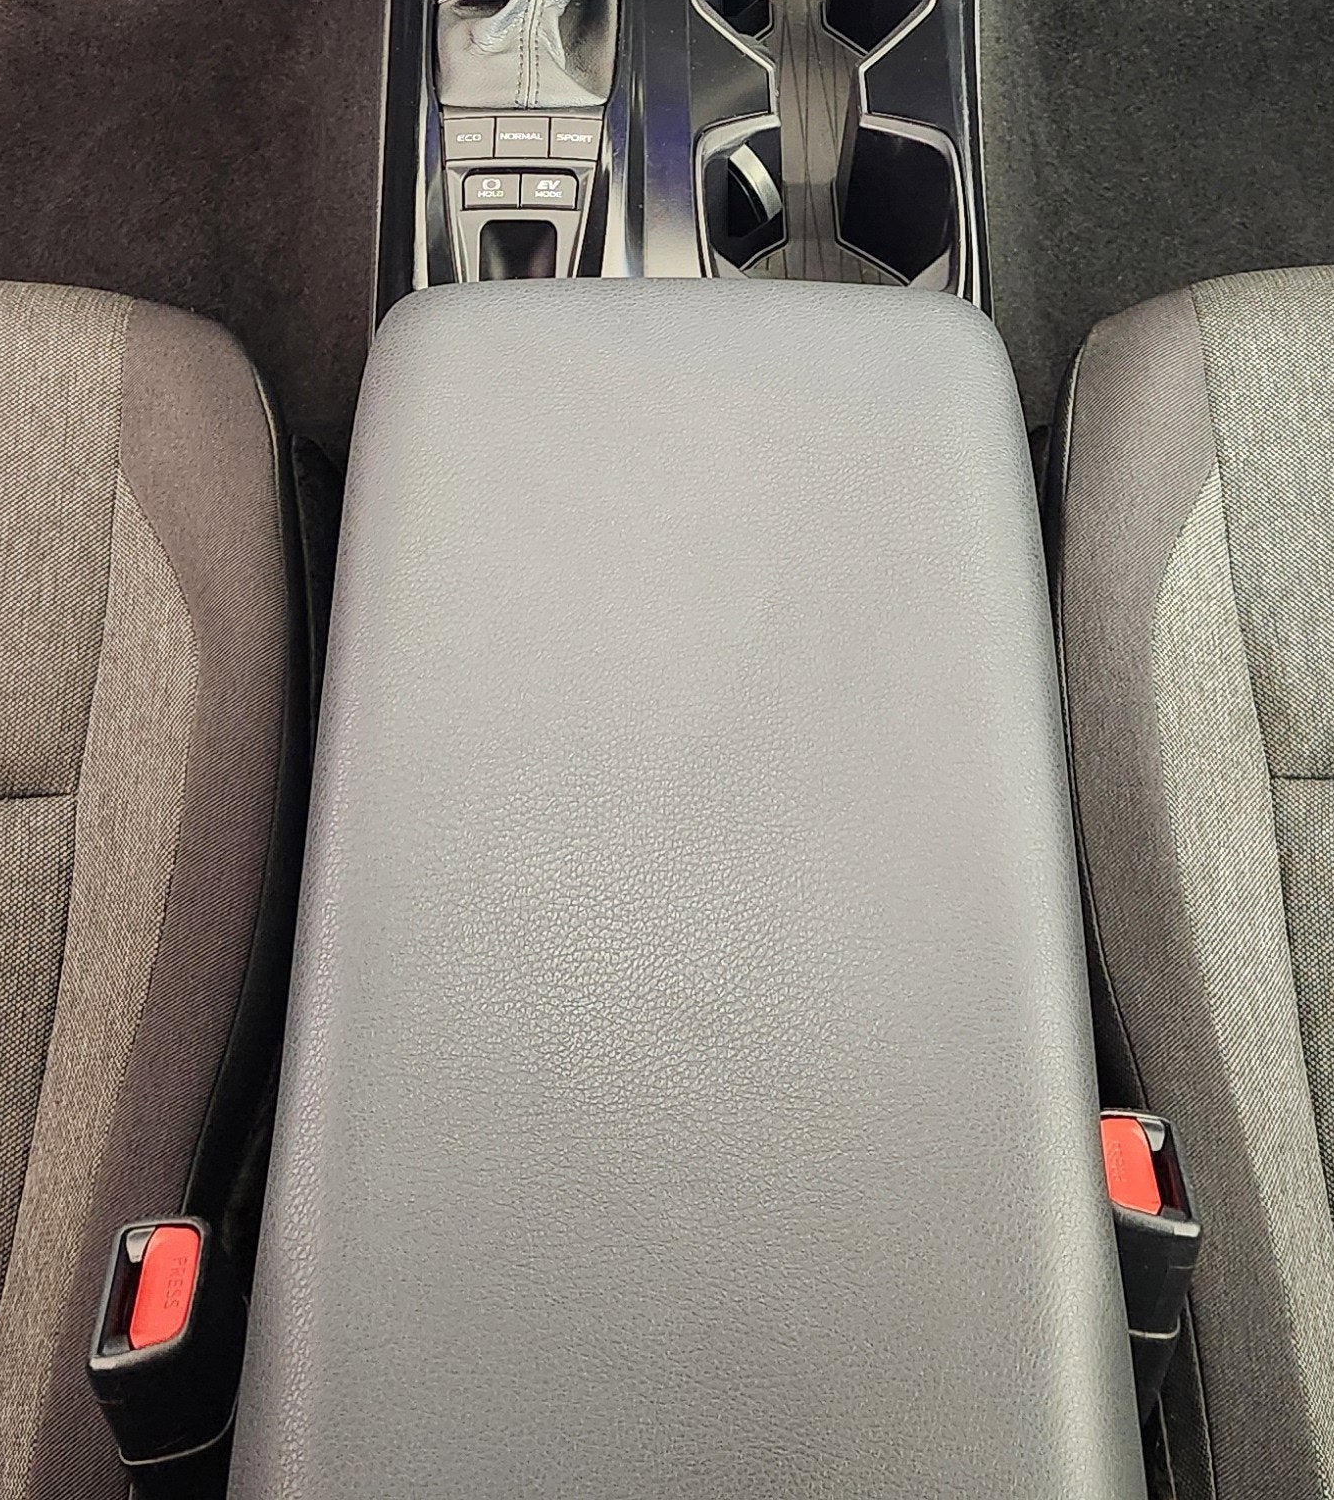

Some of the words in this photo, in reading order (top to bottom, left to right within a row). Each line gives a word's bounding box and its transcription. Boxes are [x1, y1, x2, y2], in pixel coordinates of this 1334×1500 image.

[456, 133, 482, 142] ECO
[499, 132, 543, 141] NORMAL
[556, 133, 593, 143] SPORT
[536, 180, 561, 190] EV
[163, 1256, 188, 1310] PRESS
